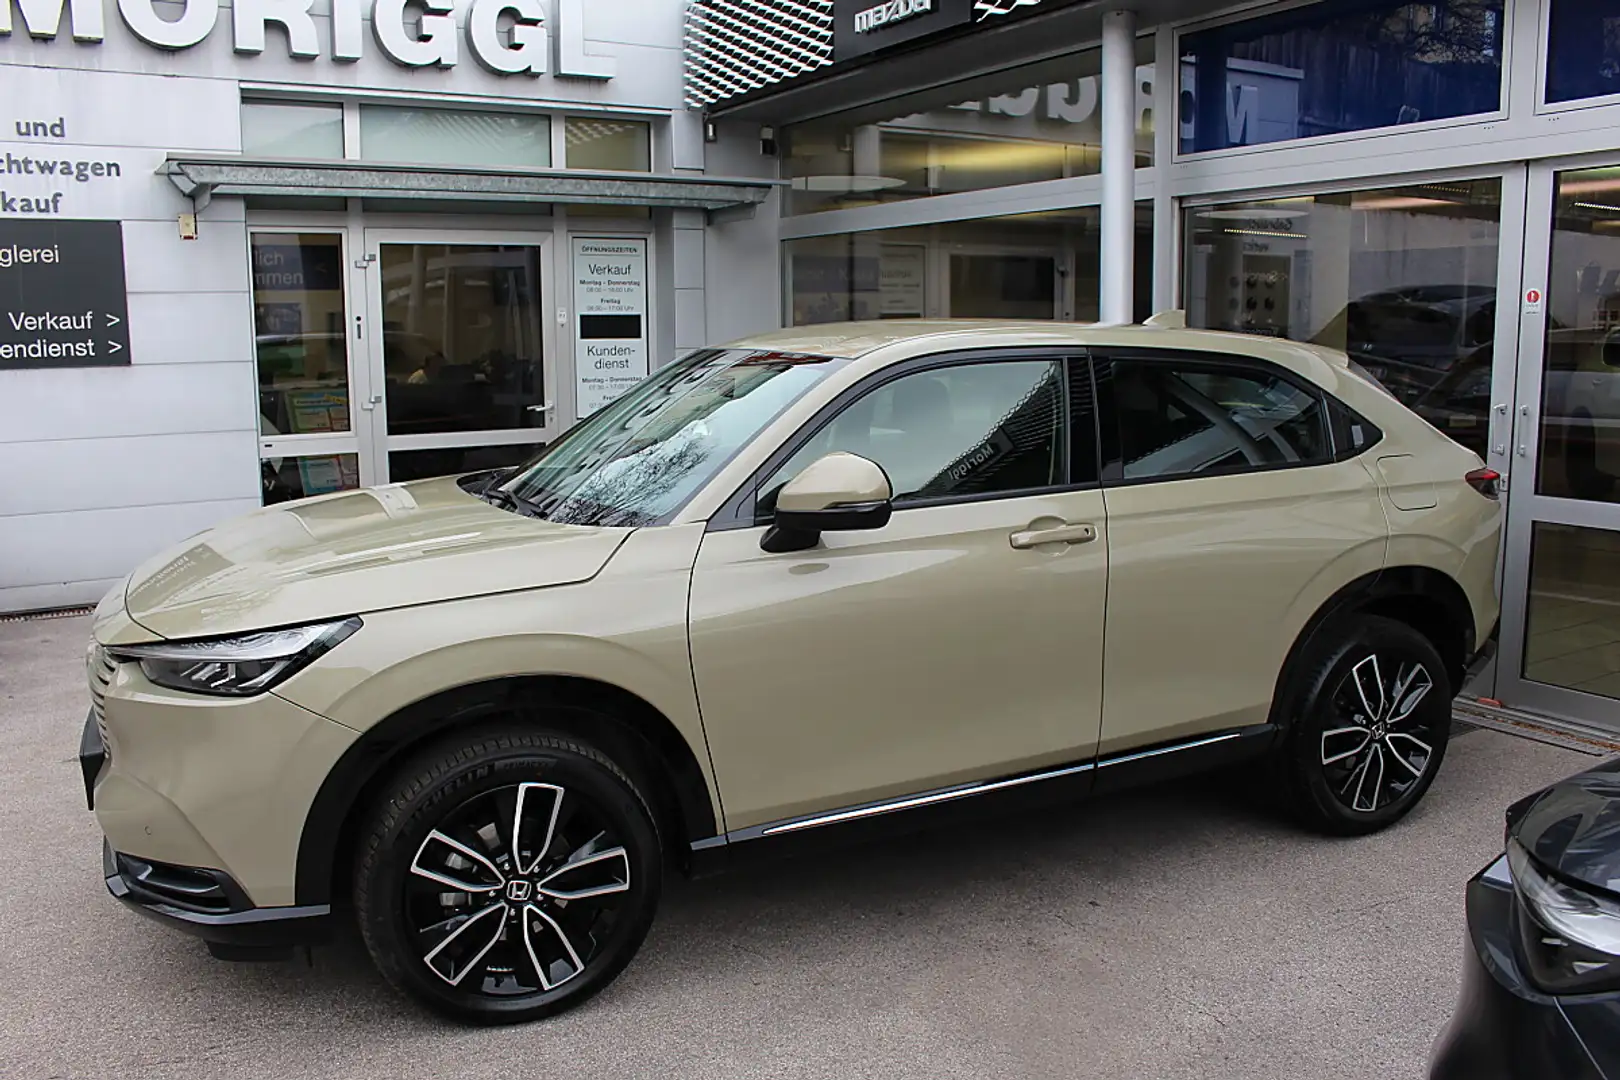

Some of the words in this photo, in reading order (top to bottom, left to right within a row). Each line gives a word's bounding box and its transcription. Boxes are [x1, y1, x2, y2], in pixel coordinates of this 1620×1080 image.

[15, 117, 65, 138] und
[1, 191, 63, 213] kauf
[0, 245, 59, 268] glerei
[588, 263, 632, 276] Verkauf
[8, 311, 93, 330] Verkauf
[0, 339, 95, 358] endienst
[587, 345, 636, 356] Kunden-
[594, 358, 629, 369] dienst
